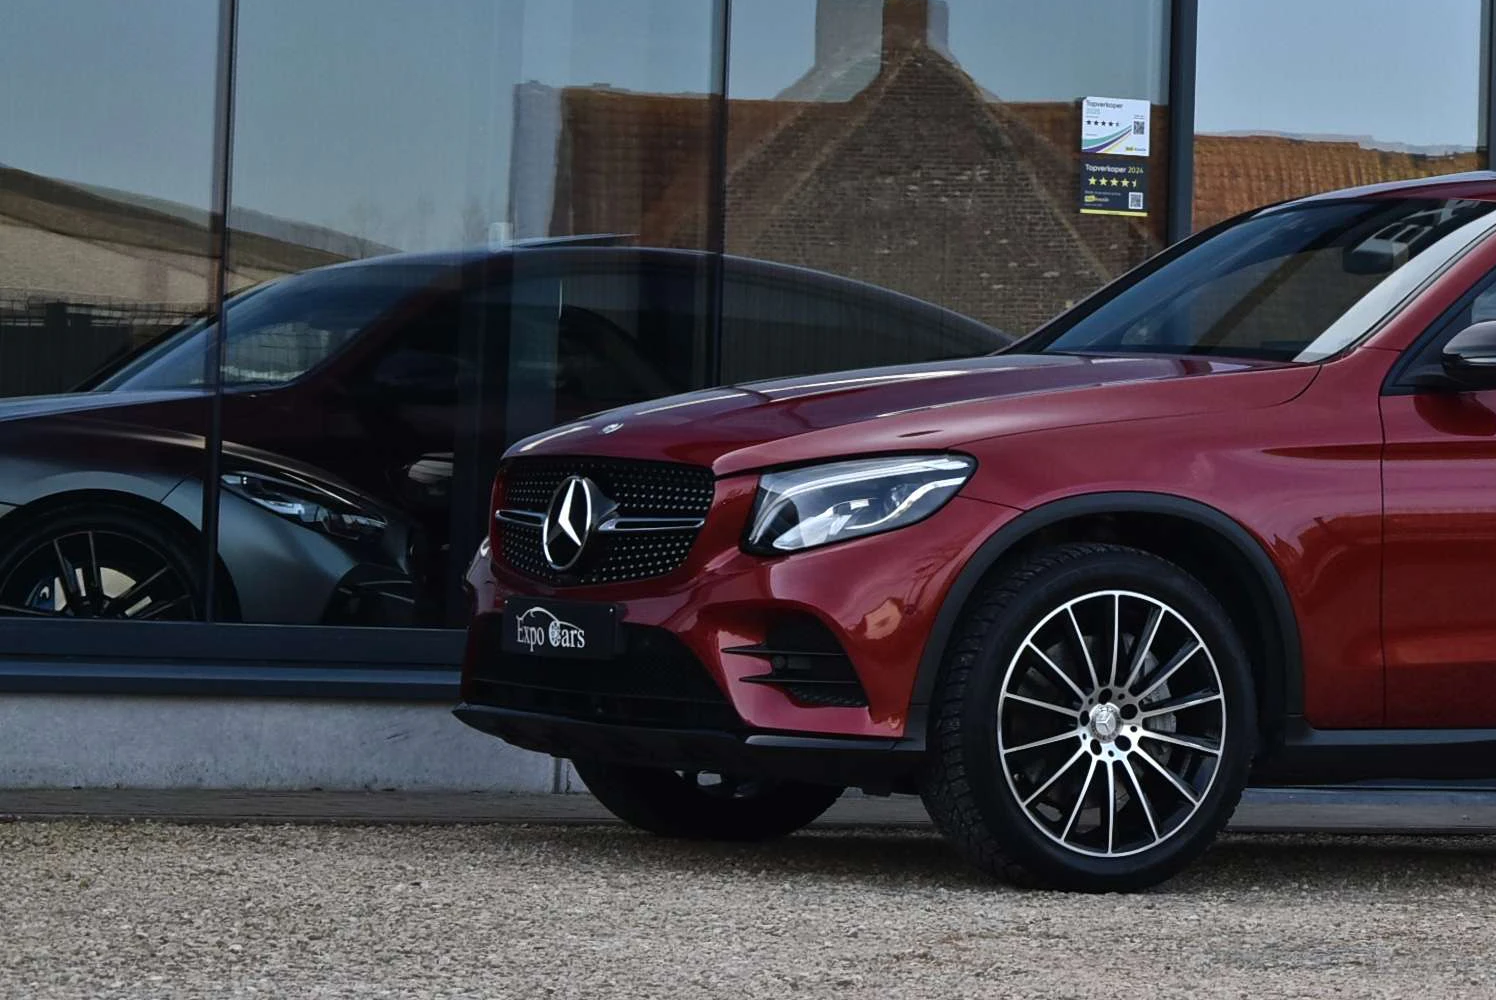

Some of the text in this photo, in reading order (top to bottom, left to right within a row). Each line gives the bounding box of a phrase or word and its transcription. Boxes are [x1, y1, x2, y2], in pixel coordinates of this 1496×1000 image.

[1085, 164, 1144, 174] Topverkoper 2024
[515, 615, 586, 652] Expo Cars
